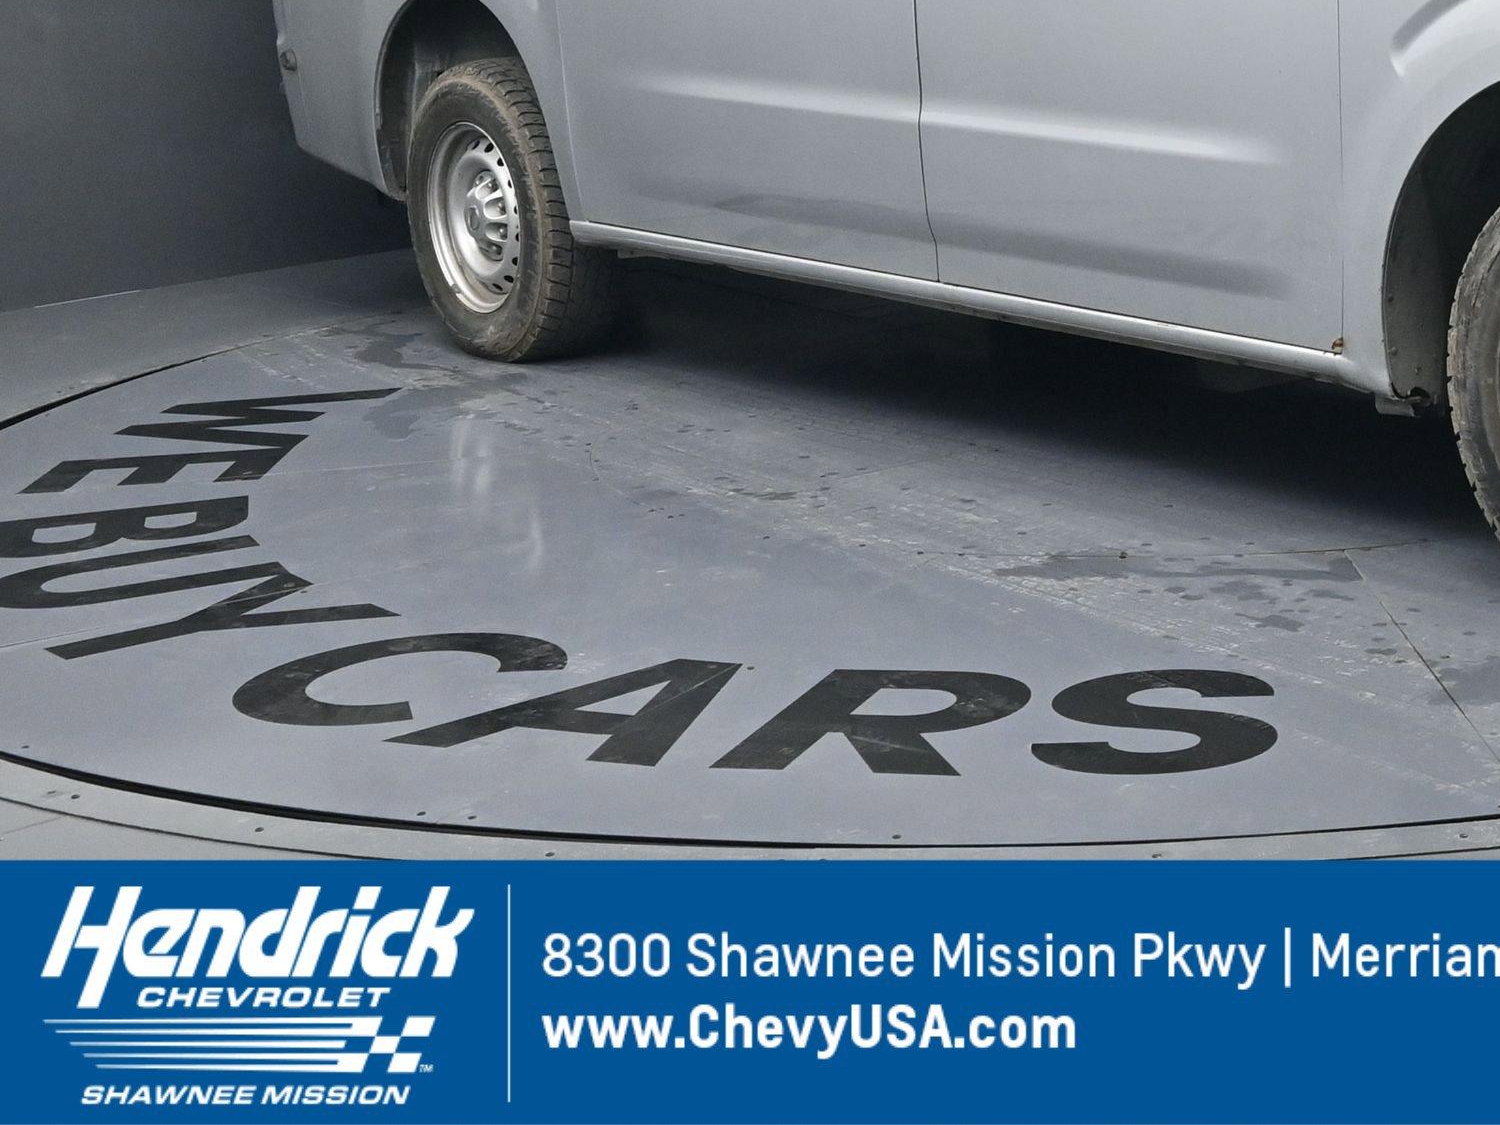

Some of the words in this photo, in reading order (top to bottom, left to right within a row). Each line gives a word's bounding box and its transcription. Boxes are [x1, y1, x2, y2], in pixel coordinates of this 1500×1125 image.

[16, 387, 402, 494] WE
[0, 495, 400, 660] BUY
[232, 632, 1278, 776] CARS
